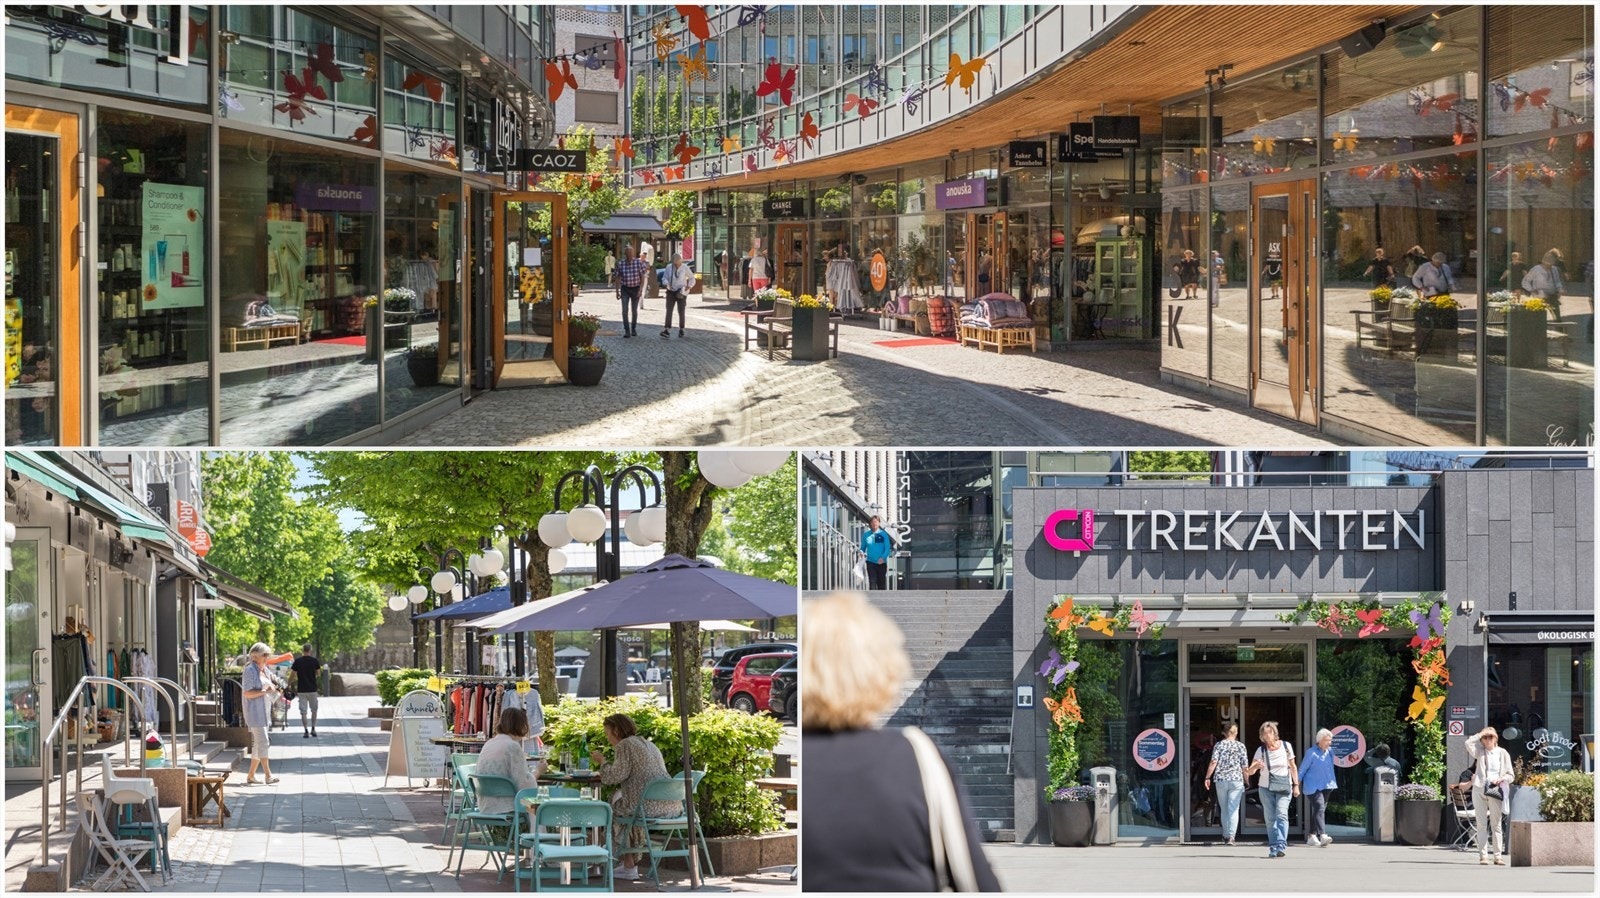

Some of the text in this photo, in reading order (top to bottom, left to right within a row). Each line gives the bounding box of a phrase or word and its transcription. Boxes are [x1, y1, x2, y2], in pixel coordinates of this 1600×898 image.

[532, 154, 577, 167] CAOZ
[149, 189, 178, 199] Shampoo
[946, 182, 972, 197] anouska
[149, 200, 184, 210] Conditioner
[772, 201, 792, 209] CHANGE
[1268, 242, 1281, 252] ASK
[180, 501, 194, 523] ARK
[1114, 509, 1425, 550] TREKANTEN
[1537, 631, 1587, 640] ØKOLOGISK
[406, 702, 438, 713] AnneBe
[1526, 732, 1578, 751] Godt Brød
